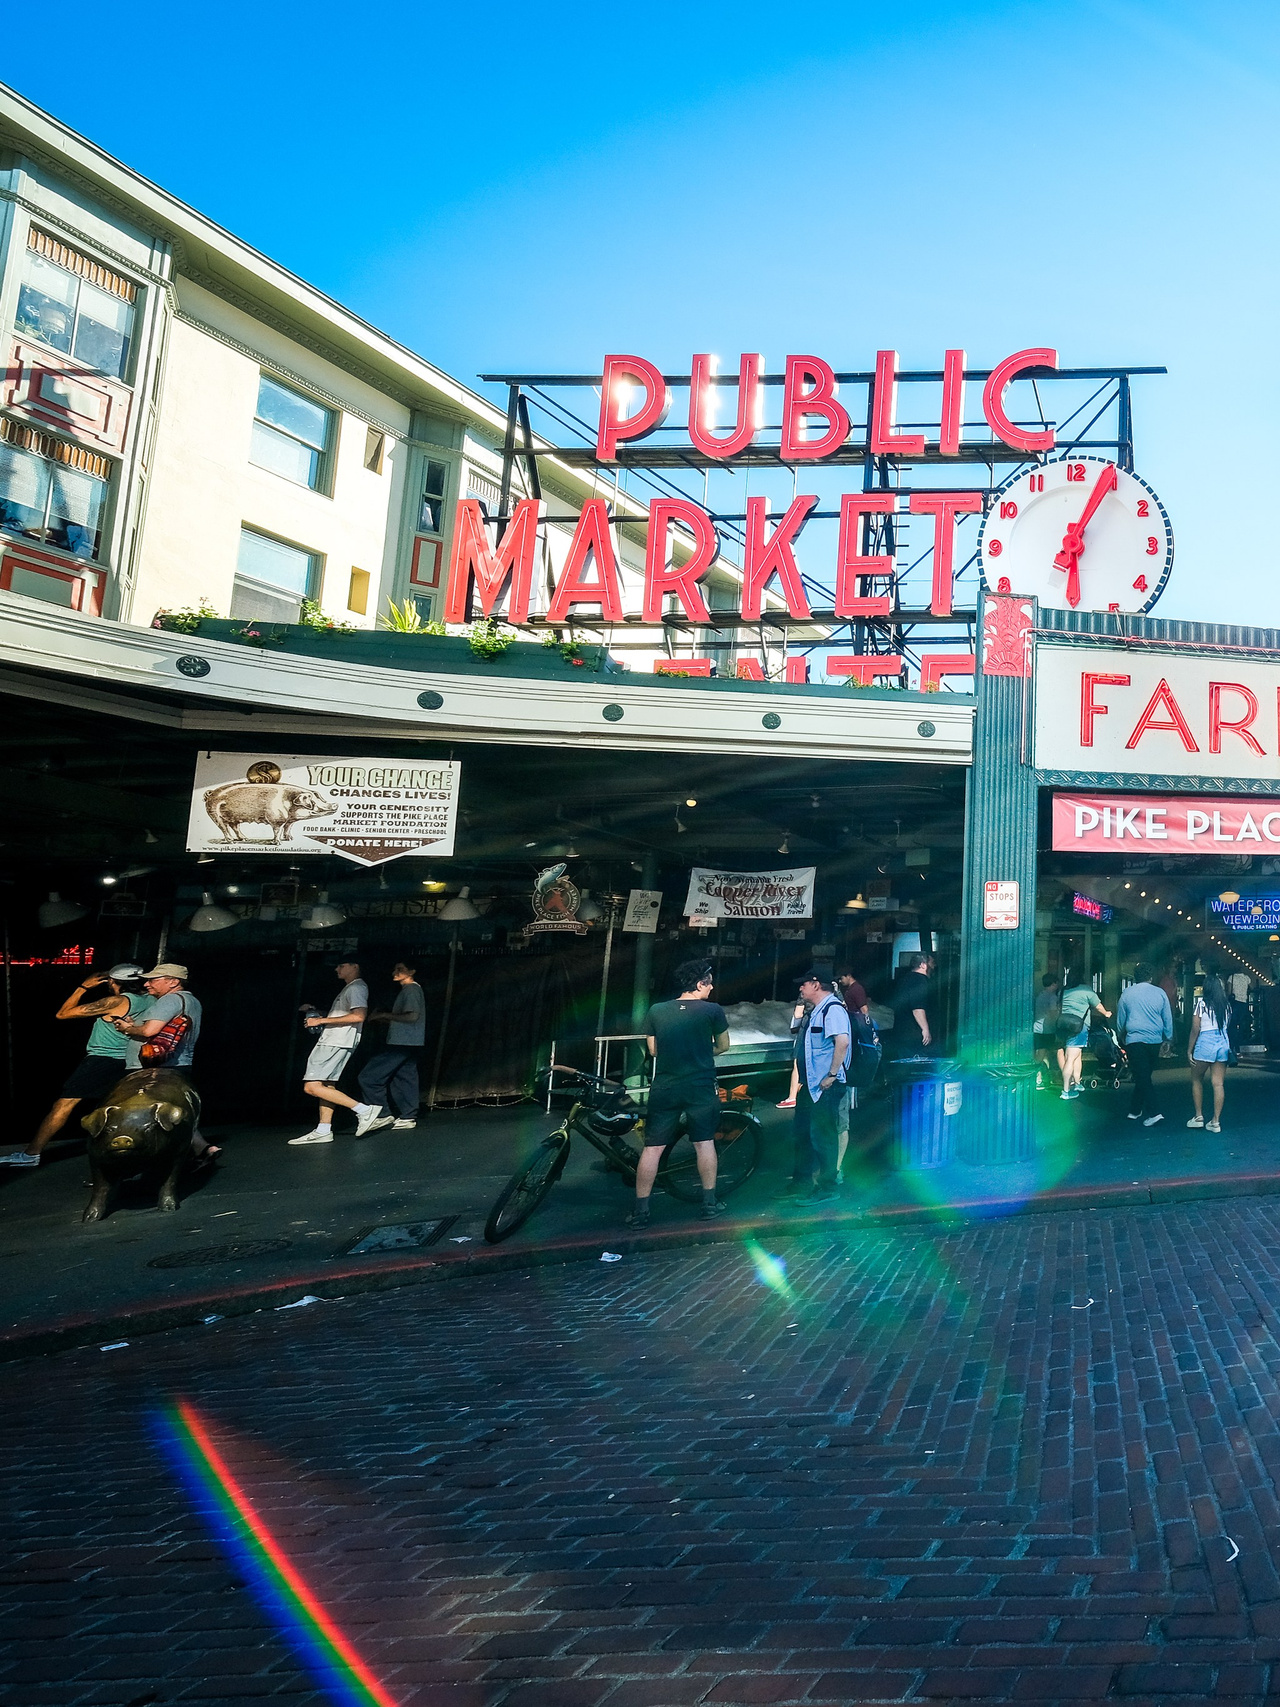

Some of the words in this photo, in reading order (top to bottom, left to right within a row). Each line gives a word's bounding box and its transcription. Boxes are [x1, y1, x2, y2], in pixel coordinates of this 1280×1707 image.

[596, 347, 1061, 462] PUBLIC
[1066, 463, 1086, 482] 12
[1029, 474, 1044, 493] 11
[999, 501, 1018, 519] 10
[1136, 499, 1149, 517] 2
[988, 538, 1003, 557] 9
[1145, 536, 1159, 555] 3
[443, 492, 984, 624] MARKET
[997, 576, 1012, 594] 8
[1132, 574, 1148, 592] 4
[307, 765, 366, 788] YOUR
[368, 768, 453, 790] CHANGE
[329, 788, 401, 799] CHANGES
[405, 791, 451, 800] LIVES!
[340, 811, 384, 819] SUPPORTS
[347, 803, 377, 811] YOUR
[379, 804, 450, 812] GENEROSITY
[1075, 807, 1168, 839] PIKE
[326, 838, 381, 847] DONATE
[383, 840, 424, 848] HERE!
[773, 874, 794, 883] Fresh
[986, 883, 998, 891] NO
[706, 881, 759, 901] Copper
[763, 883, 807, 897] River
[989, 893, 1015, 901] STOPS
[537, 907, 554, 919] PLACE
[569, 889, 579, 911] MARKET
[723, 901, 781, 917] Salmon
